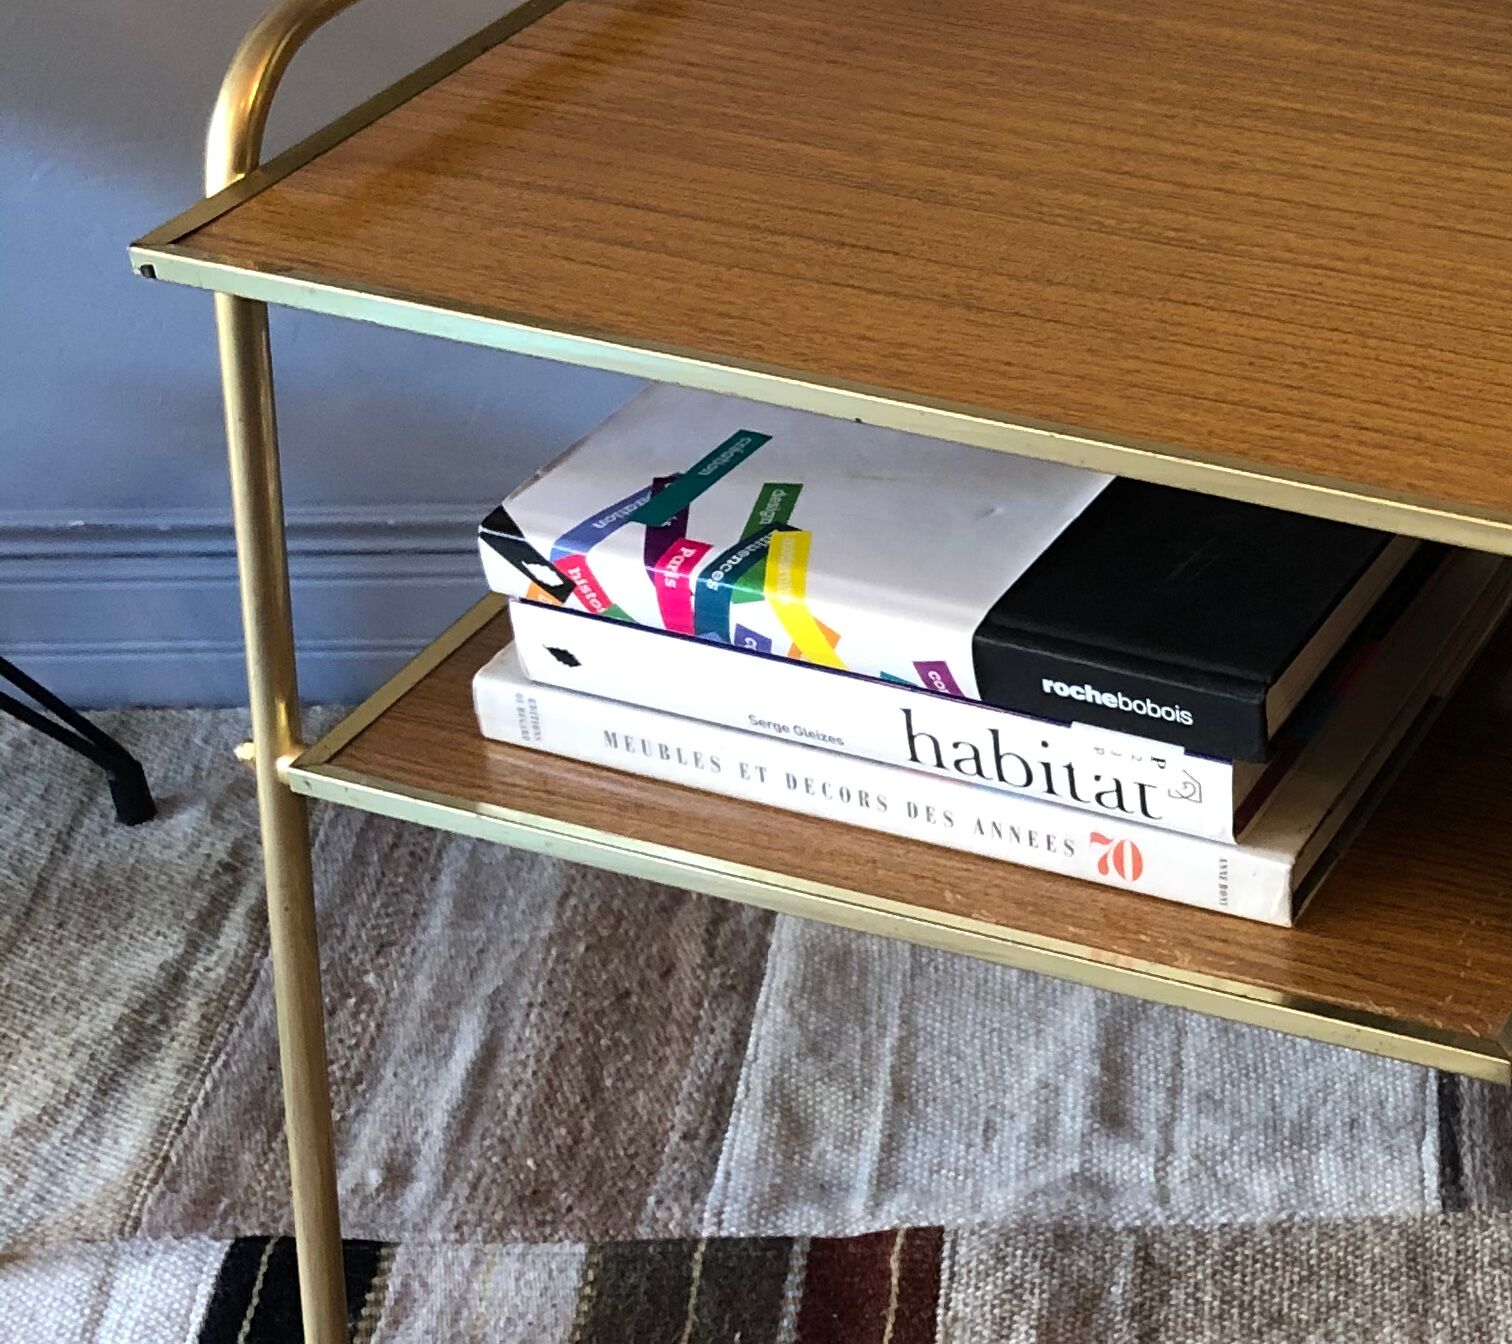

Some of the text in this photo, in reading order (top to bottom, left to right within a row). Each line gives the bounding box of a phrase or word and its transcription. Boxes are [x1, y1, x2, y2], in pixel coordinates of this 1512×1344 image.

[760, 488, 787, 525] design
[664, 546, 697, 589] Paris
[1042, 678, 1194, 726] rochebobois
[748, 714, 845, 746] Serge Gleizes
[900, 707, 1163, 820] habitat
[603, 729, 1144, 883] MEUBLES ET DECORS DES ANNEES 70
